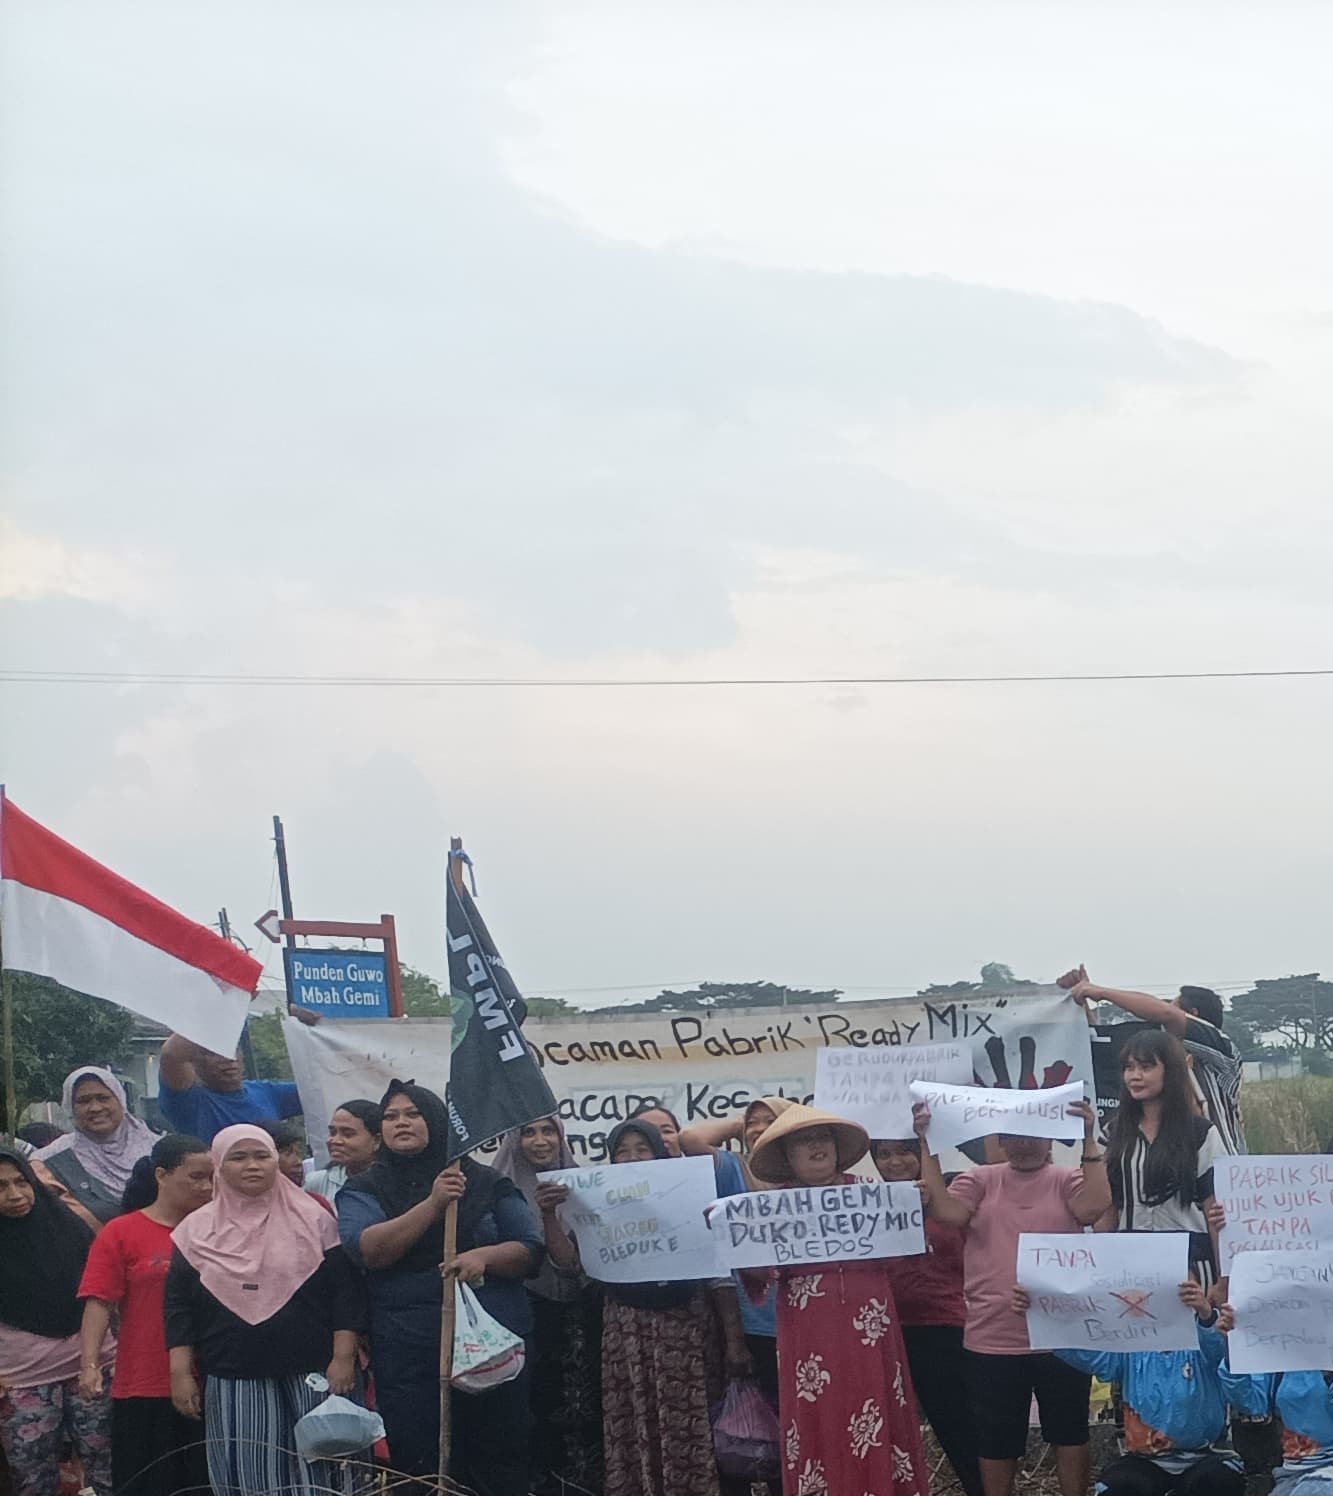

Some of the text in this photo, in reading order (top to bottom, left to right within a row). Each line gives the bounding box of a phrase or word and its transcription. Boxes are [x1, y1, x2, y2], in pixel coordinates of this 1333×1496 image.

[293, 961, 384, 983] Punden Guwo
[301, 986, 381, 1006] Mbah Gemi
[1228, 1165, 1301, 1191] PABRIK
[726, 1185, 894, 1221] MBAH GEMI
[884, 1209, 921, 1232] MIC
[1242, 1216, 1313, 1238] TANPA
[774, 1236, 875, 1264] BLEDOS
[1030, 1248, 1097, 1269] TANPA
